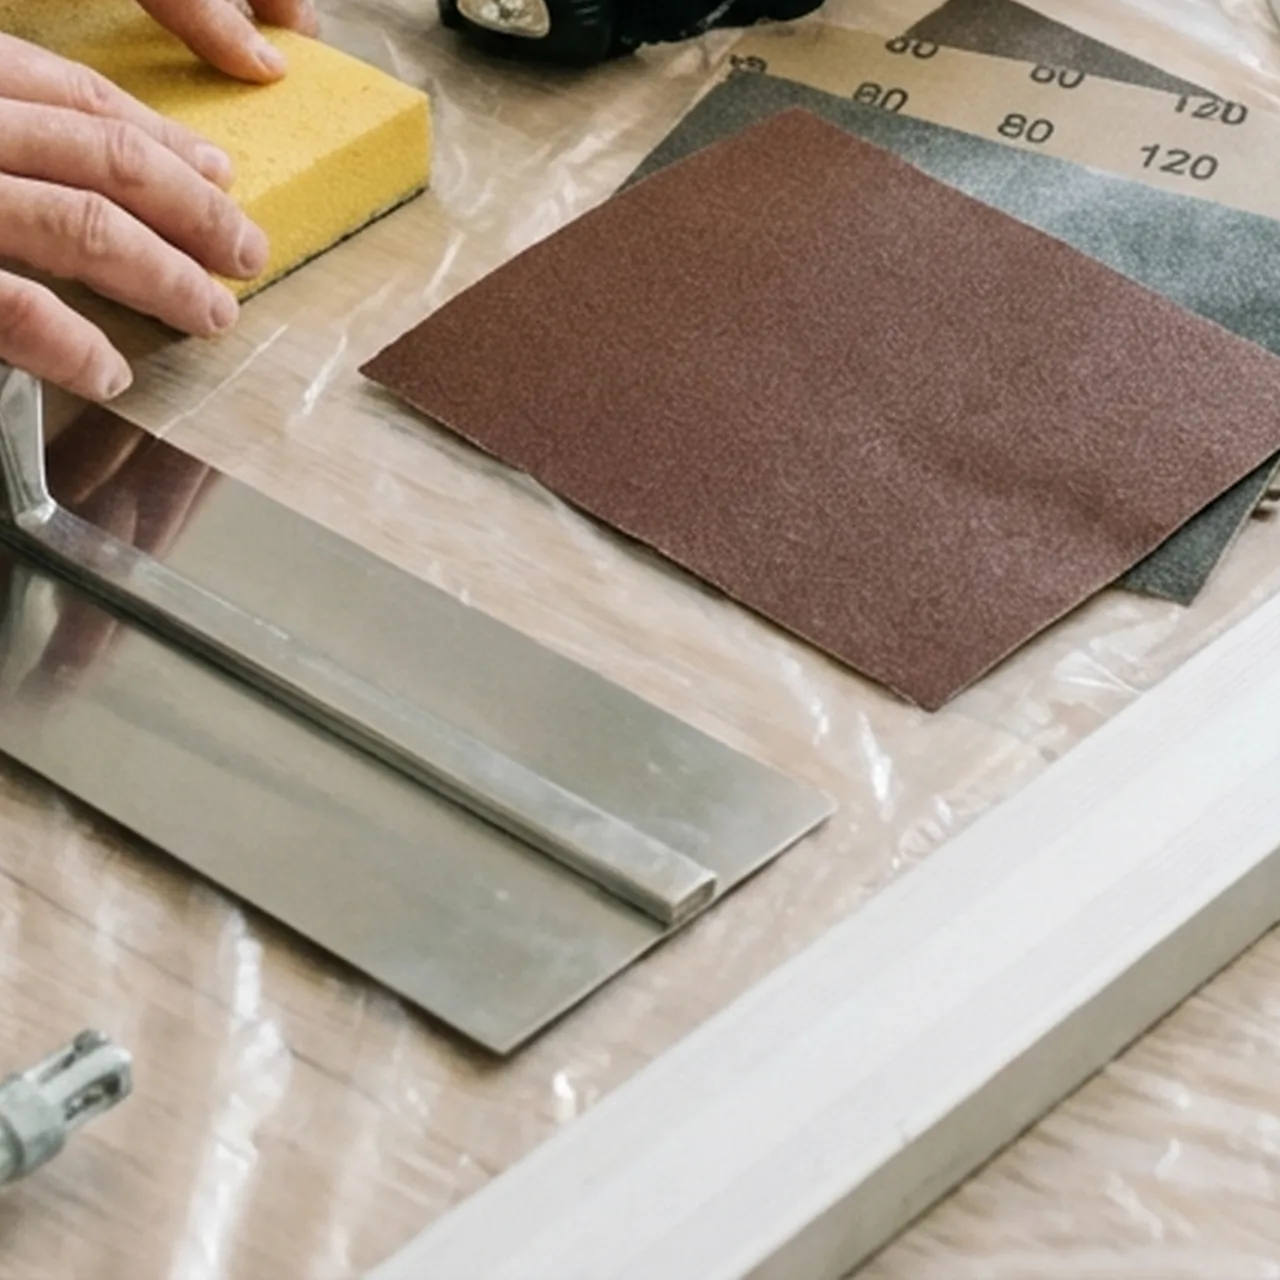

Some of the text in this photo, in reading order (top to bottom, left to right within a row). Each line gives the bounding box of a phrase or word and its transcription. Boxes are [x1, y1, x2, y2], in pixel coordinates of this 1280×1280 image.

[852, 81, 909, 112] 80
[997, 113, 1054, 144] 80
[1140, 144, 1218, 180] 120
